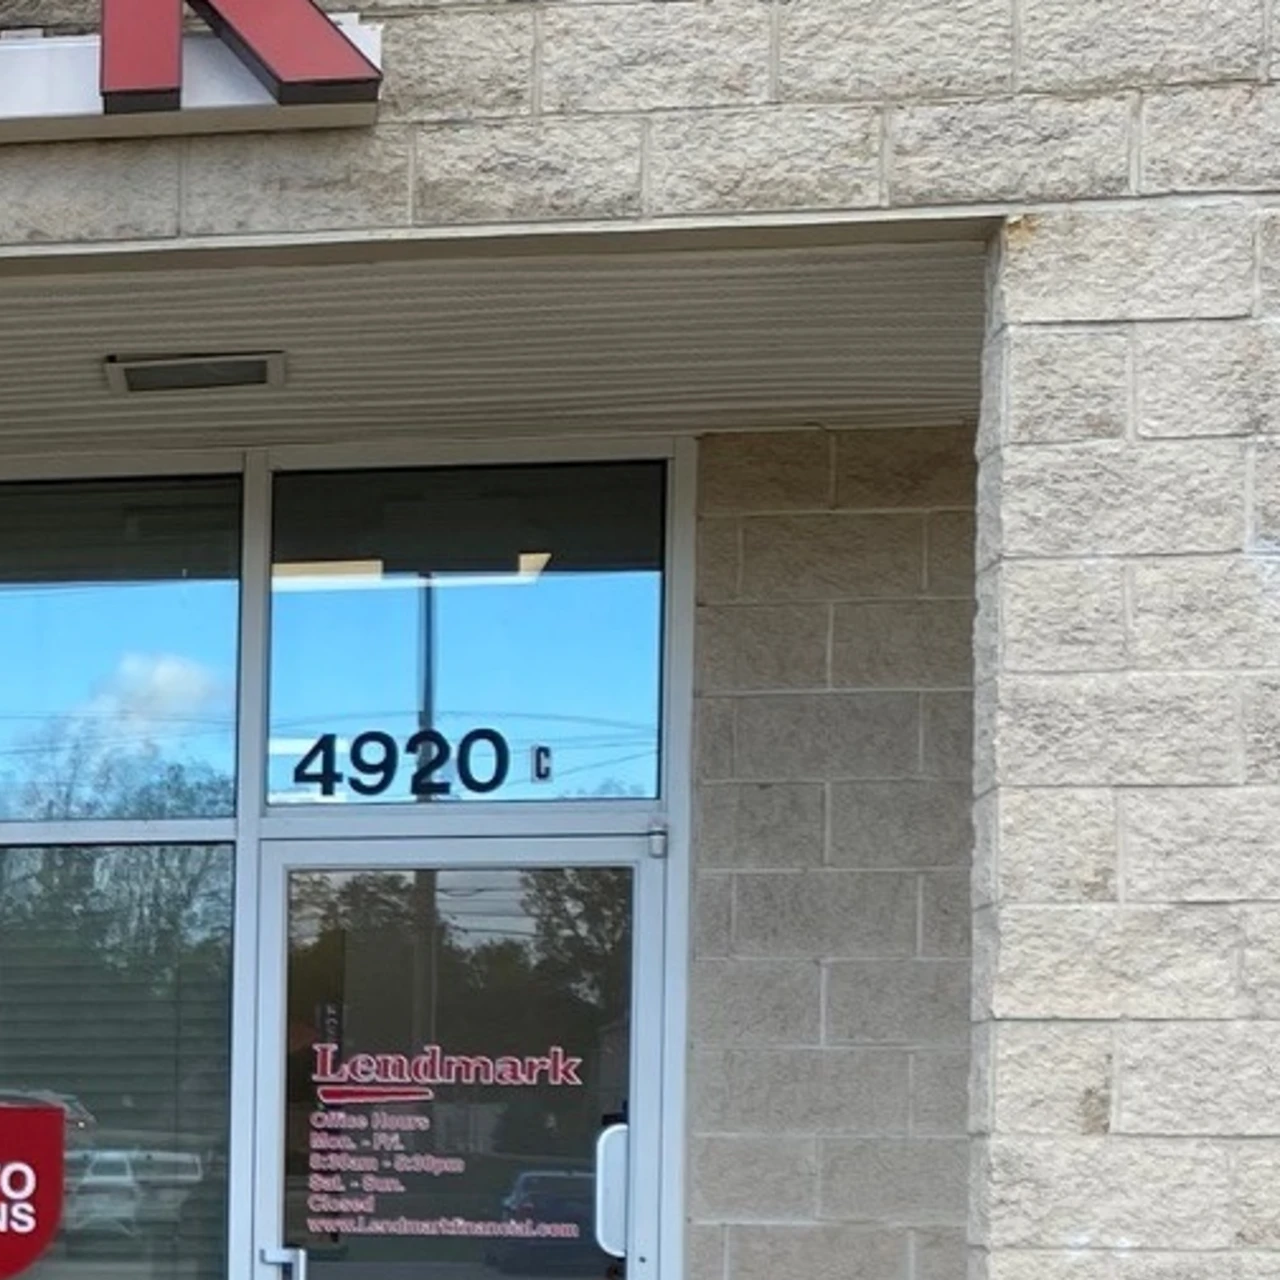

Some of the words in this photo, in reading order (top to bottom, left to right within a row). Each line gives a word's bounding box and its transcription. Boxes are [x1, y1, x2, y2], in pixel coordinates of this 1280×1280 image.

[293, 728, 509, 796] 4920
[312, 1043, 583, 1086] Lendmark
[371, 1112, 430, 1131] Hours
[307, 1193, 376, 1213] Closed
